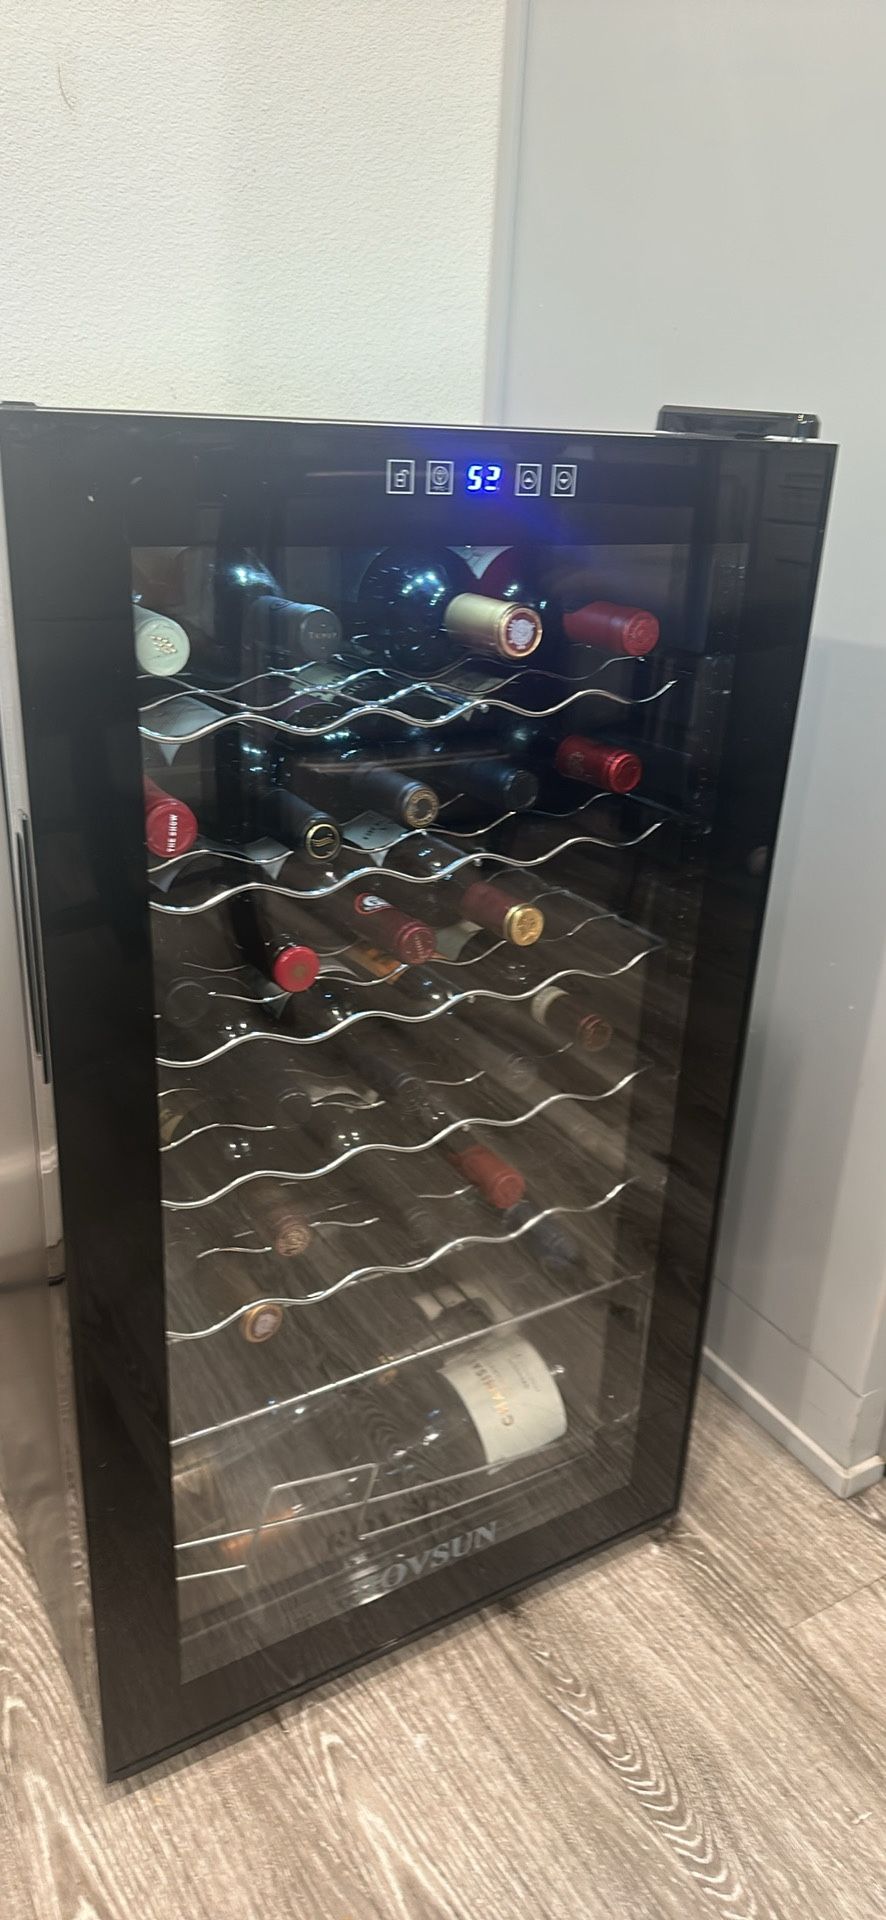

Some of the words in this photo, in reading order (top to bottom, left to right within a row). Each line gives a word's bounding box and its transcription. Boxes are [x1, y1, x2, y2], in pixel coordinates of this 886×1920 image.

[467, 465, 501, 491] 52
[168, 814, 178, 836] SHOW
[166, 838, 176, 853] THE
[354, 1521, 497, 1604] OVSUN
